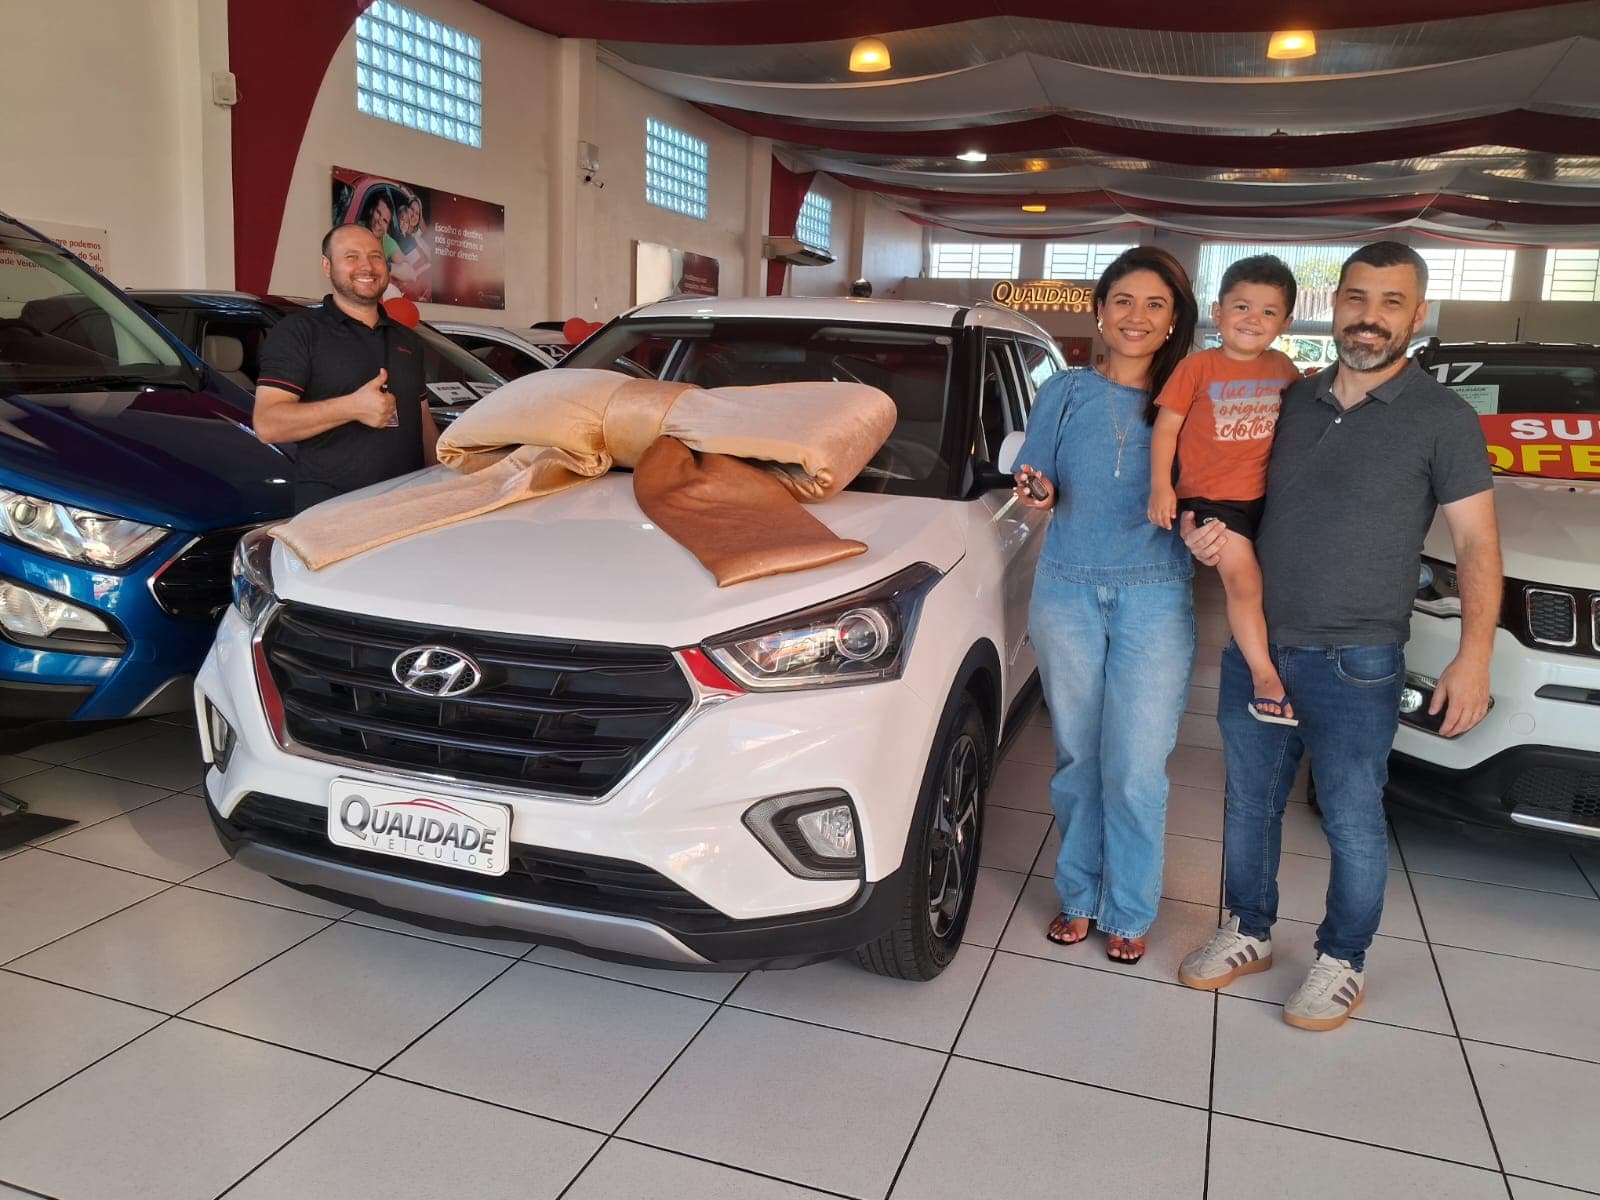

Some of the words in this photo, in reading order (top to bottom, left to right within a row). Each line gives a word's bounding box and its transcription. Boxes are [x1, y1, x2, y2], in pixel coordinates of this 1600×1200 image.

[69, 239, 101, 250] podemos
[78, 251, 88, 260] do
[992, 280, 1092, 307] QUALIDADE
[1428, 362, 1484, 383] 17
[1510, 418, 1600, 440] SU
[340, 794, 497, 855] QUALIDADE
